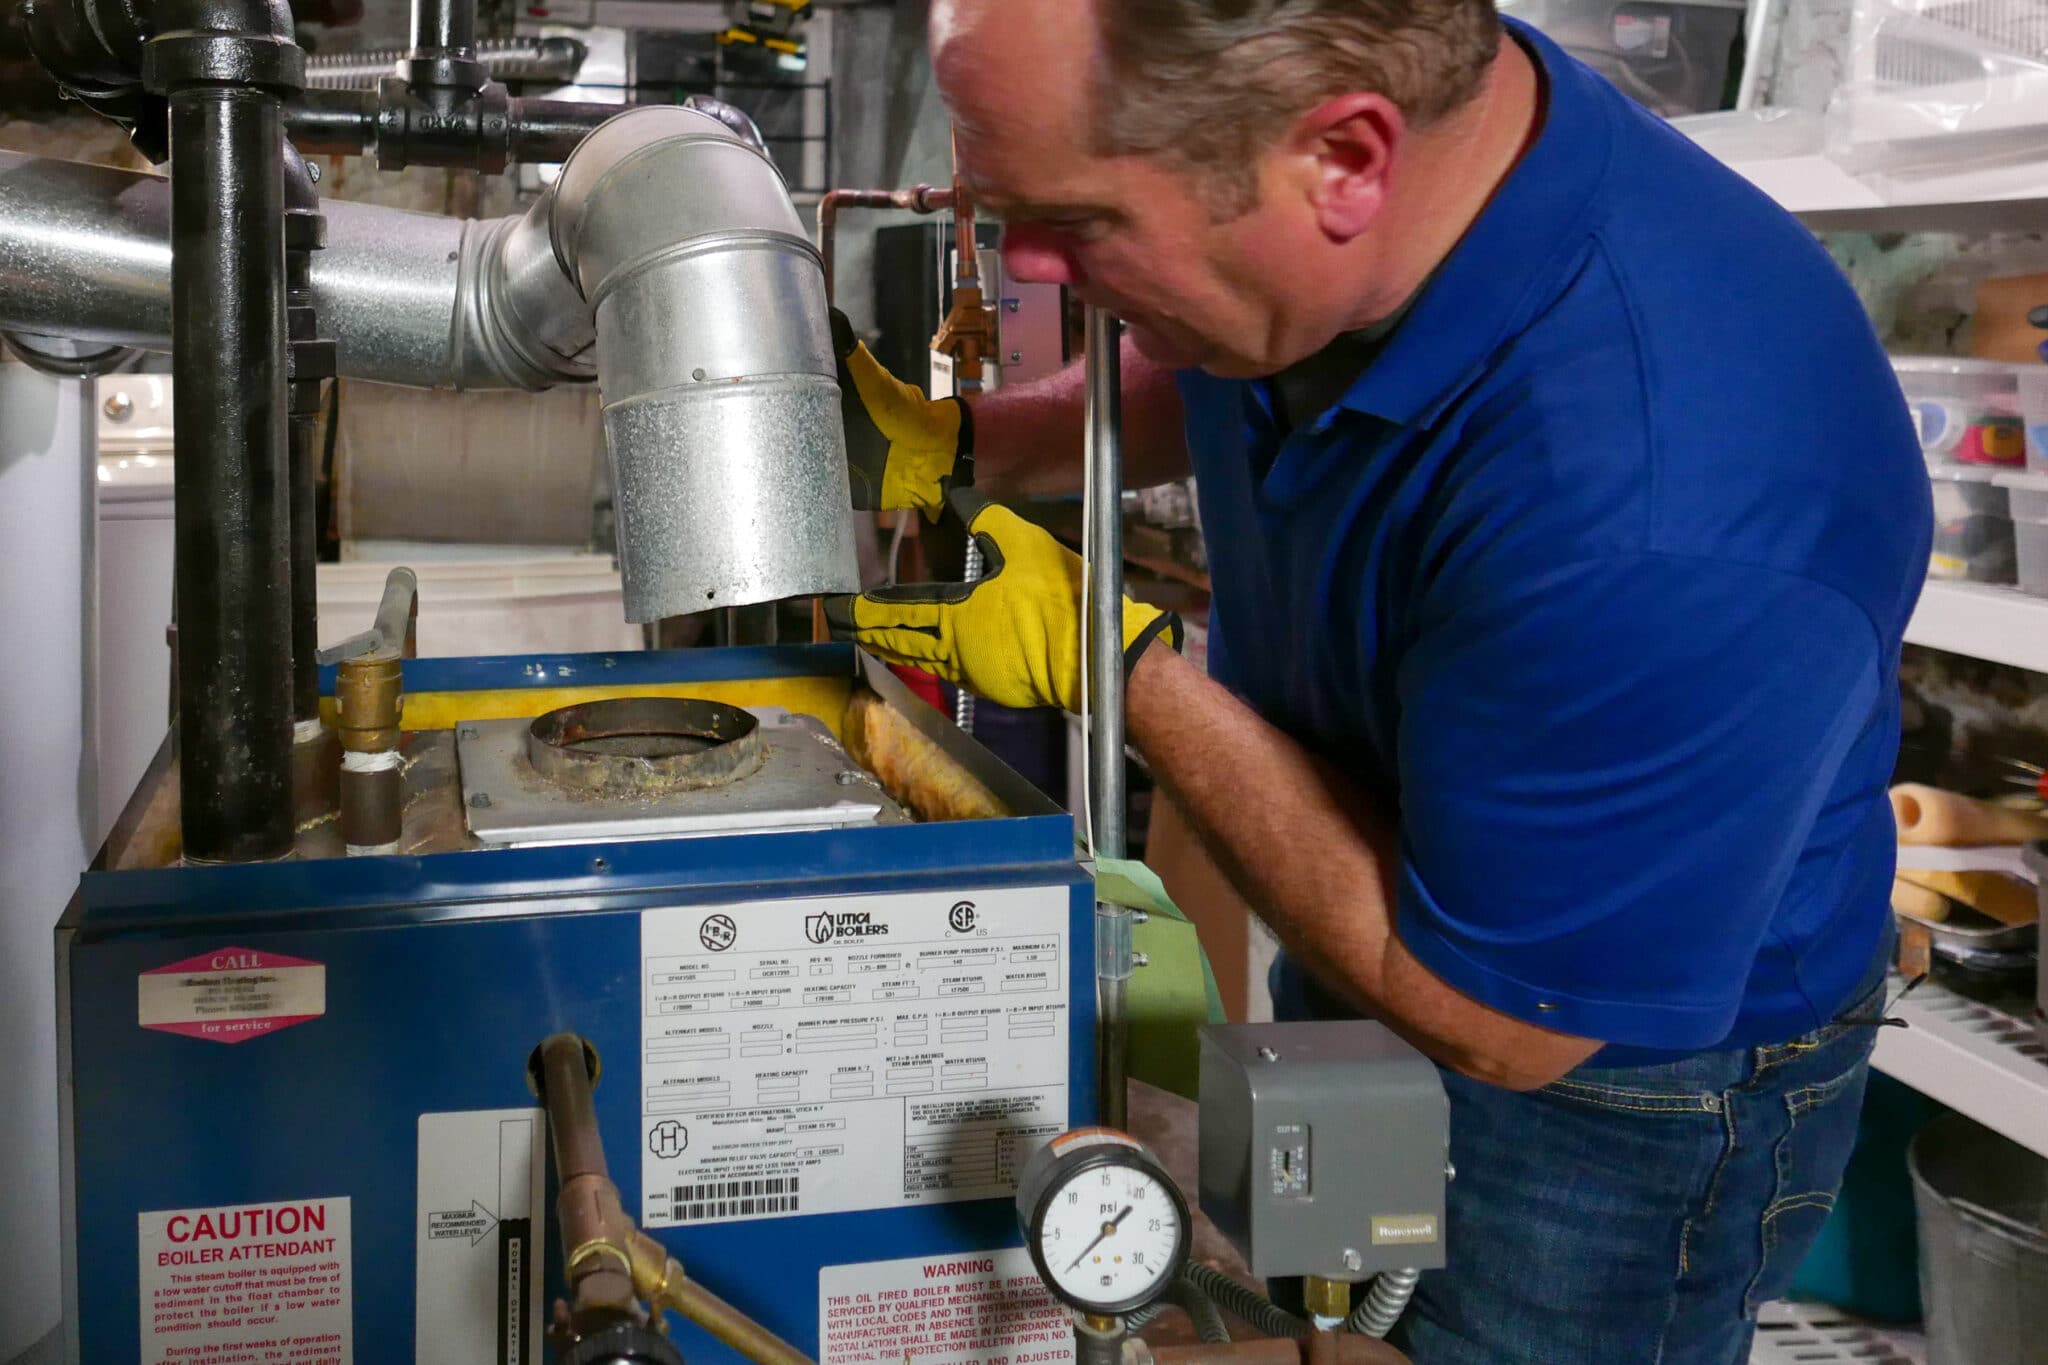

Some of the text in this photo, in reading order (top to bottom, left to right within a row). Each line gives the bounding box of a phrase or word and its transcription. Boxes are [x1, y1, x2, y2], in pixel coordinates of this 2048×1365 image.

[836, 912, 870, 926] UTICA
[948, 900, 976, 933] CSA
[836, 924, 889, 938] BOILERS
[976, 928, 988, 937] US
[211, 954, 263, 970] CALL
[869, 952, 902, 960] FURNISHED
[830, 983, 856, 991] CAPACITY
[201, 1020, 272, 1033] for service
[839, 1017, 868, 1025] PRESSURE
[665, 1026, 722, 1036] ALTERNATE MODELS
[781, 1069, 808, 1077] CAPACITY
[662, 1077, 695, 1085] ALTERNATE
[921, 1102, 955, 1110] INSTALLATION
[696, 1112, 725, 1120] CERTIFIED
[712, 1118, 750, 1126] Manufactured
[798, 1123, 817, 1131] STEAM
[660, 1126, 678, 1152] H
[700, 1157, 728, 1165] MINIMUM
[749, 1153, 767, 1161] VALVE
[769, 1151, 796, 1159] CAPACITY
[678, 1167, 711, 1176] ELECTRICAL
[727, 1170, 765, 1178] ACCORDANCE
[1101, 1174, 1111, 1186] 15
[1068, 1192, 1078, 1204] 10
[1100, 1202, 1118, 1214] psi
[441, 1212, 476, 1220] MAXIMUM
[166, 1205, 325, 1243] CAUTION
[431, 1219, 487, 1229] RECOMMENDED
[1148, 1220, 1161, 1232] 25
[434, 1227, 482, 1237] WATER LEVEL
[1055, 1229, 1061, 1240] 5
[1379, 1224, 1432, 1238] Honeywell
[158, 1239, 336, 1267] BOILER ATTENDANT
[1132, 1252, 1144, 1264] 30
[510, 1241, 518, 1290] NORMAL
[923, 1258, 994, 1279] WARNING
[171, 1262, 340, 1284] This steam boiler is equipped with
[163, 1288, 180, 1297] low
[184, 1286, 209, 1295] water
[213, 1281, 242, 1292] cutoff
[245, 1281, 264, 1290] that
[267, 1278, 291, 1288] must
[294, 1276, 306, 1286] be
[308, 1275, 327, 1284] free
[330, 1273, 341, 1282] of
[154, 1286, 340, 1310] sediment in the float chamber to
[827, 1295, 851, 1307] THIS
[855, 1294, 873, 1304] OIL
[877, 1290, 908, 1302] FIRED
[913, 1285, 950, 1298] BOILER
[955, 1281, 984, 1293] MUST
[989, 1280, 1002, 1290] BE
[154, 1311, 194, 1323] protect
[200, 1308, 217, 1317] the
[224, 1305, 254, 1316] boiler
[260, 1304, 268, 1313] if
[286, 1300, 305, 1310] low
[311, 1298, 341, 1307] water
[827, 1305, 876, 1319] SERVICED
[879, 1303, 892, 1314] BY
[895, 1298, 944, 1312] QUALIFIED
[948, 1291, 1005, 1305] MECHANICS
[1008, 1289, 1019, 1299] IN
[827, 1298, 1049, 1330] WITH LOCAL CODES AND THE INSTRUCTIONS
[154, 1322, 201, 1334] condition
[207, 1318, 241, 1329] should
[915, 1322, 925, 1333] IN
[928, 1317, 975, 1331] ABSENCE
[978, 1315, 991, 1326] OF
[994, 1311, 1026, 1324] LOCAL
[827, 1319, 1061, 1353] INSTALLATION SHALL BE MADE IN ACCORDANCE
[166, 1333, 341, 1358] During the first weeks of operation
[827, 1351, 877, 1364] NATIONAL
[879, 1348, 901, 1360] FIRE
[904, 1343, 967, 1357] PROTECTION
[968, 1336, 1015, 1350] BULLETIN
[1017, 1333, 1049, 1345] (NFPA)
[264, 1350, 283, 1360] the
[289, 1345, 341, 1358] sediment
[987, 1355, 1009, 1365] AND
